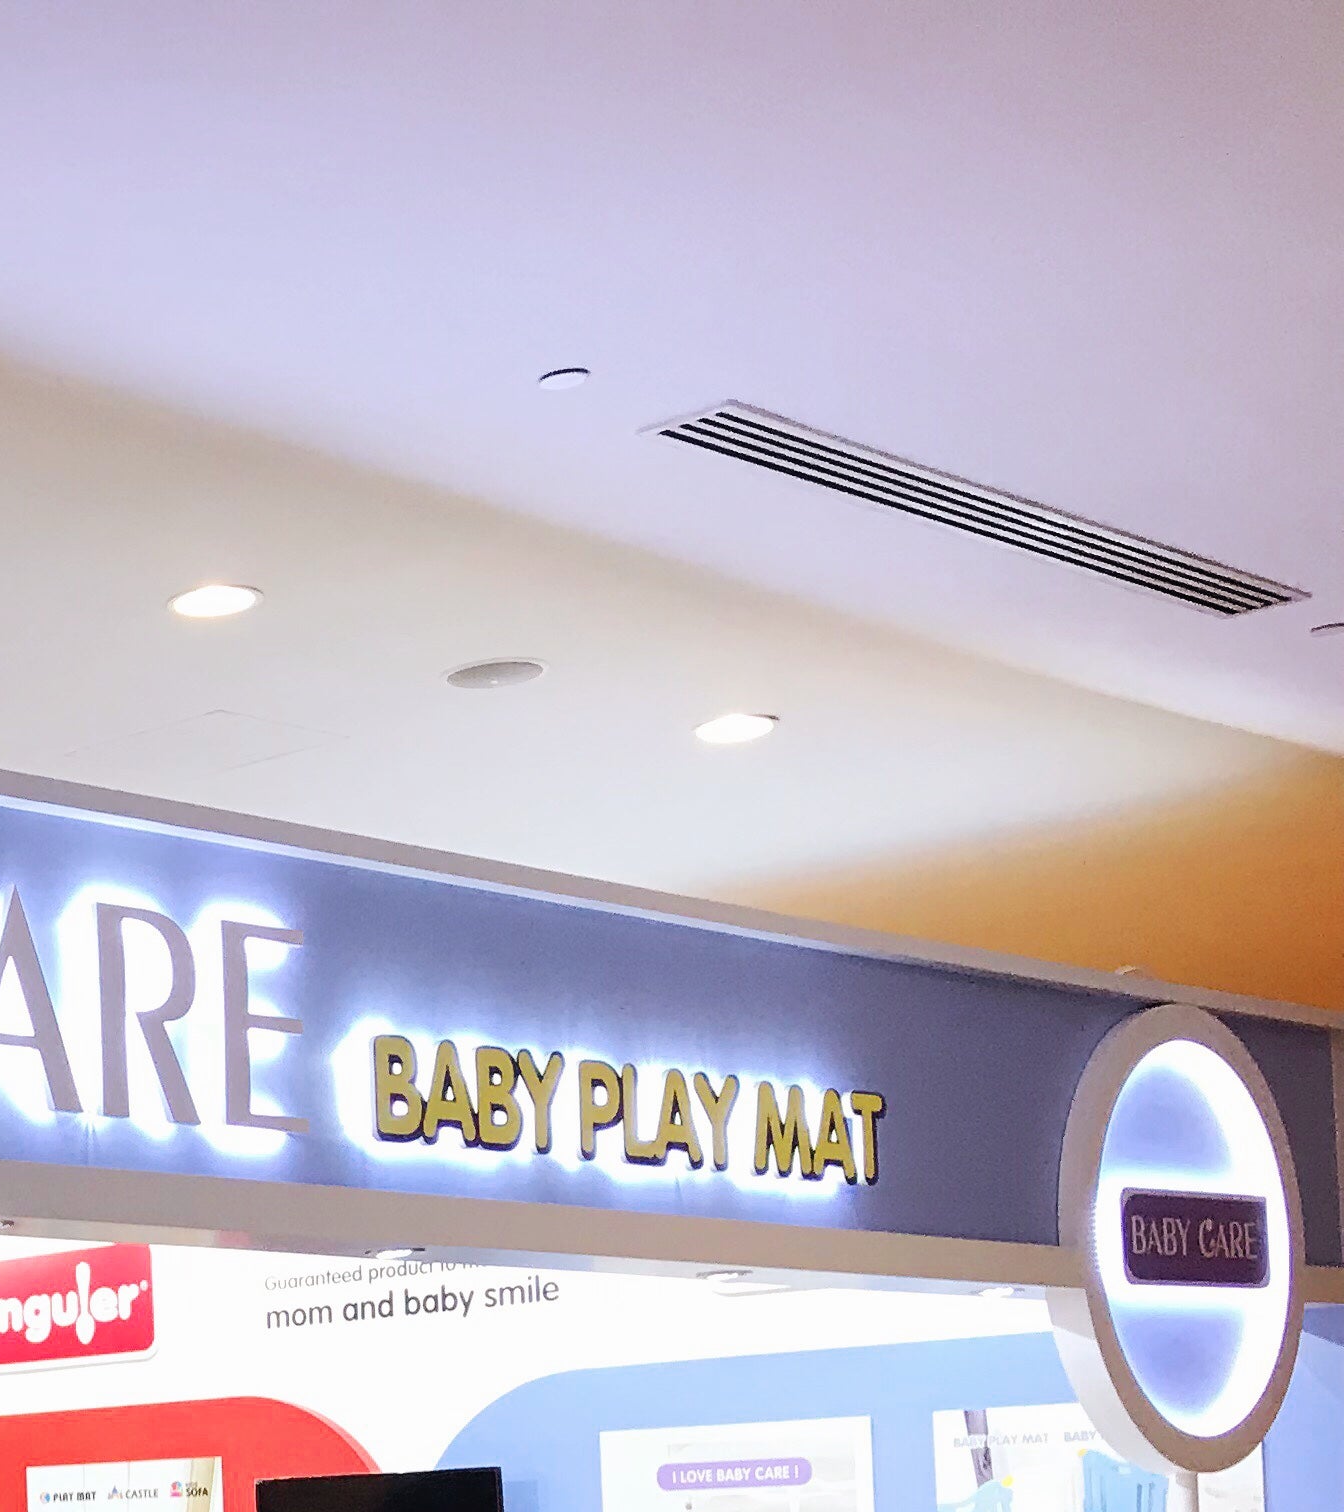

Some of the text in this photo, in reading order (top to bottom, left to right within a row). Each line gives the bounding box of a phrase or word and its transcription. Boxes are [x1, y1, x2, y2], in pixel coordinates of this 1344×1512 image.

[372, 1033, 888, 1185] BABY PLAY MAT
[1130, 1214, 1258, 1260] BABY CARE
[264, 1264, 363, 1291] Guaranteed
[266, 1274, 560, 1329] mom and baby smile
[680, 1469, 713, 1484] LOVE
[716, 1467, 751, 1482] BABY
[754, 1465, 790, 1481] CARE
[125, 1488, 159, 1499] CASTLE
[185, 1486, 209, 1498] SOFA
